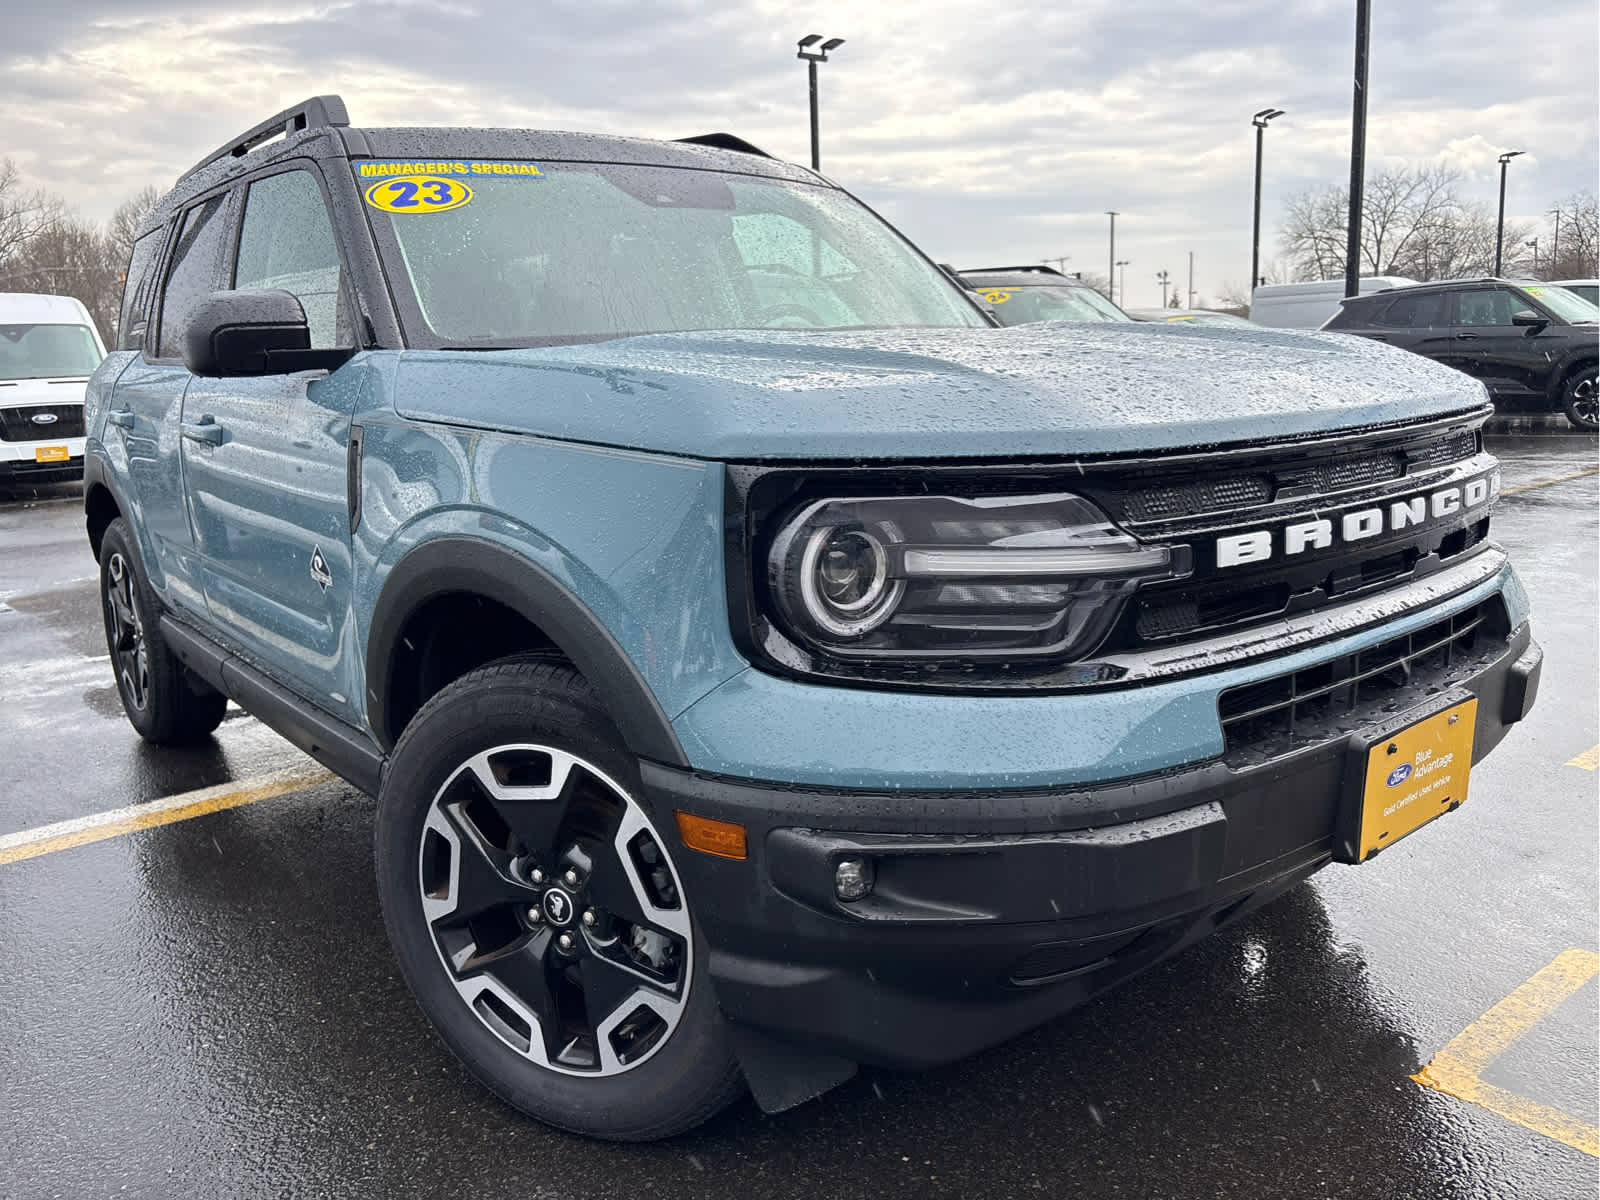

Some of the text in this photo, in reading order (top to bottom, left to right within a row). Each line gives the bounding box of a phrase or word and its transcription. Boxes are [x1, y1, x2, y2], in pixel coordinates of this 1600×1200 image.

[360, 162, 544, 177] MANAGER'S SPECIAL
[388, 181, 453, 208] 23
[1216, 478, 1487, 568] BRONCO
[1414, 752, 1453, 778] Advantage
[1415, 748, 1433, 766] Blue
[1389, 765, 1410, 786] Ford
